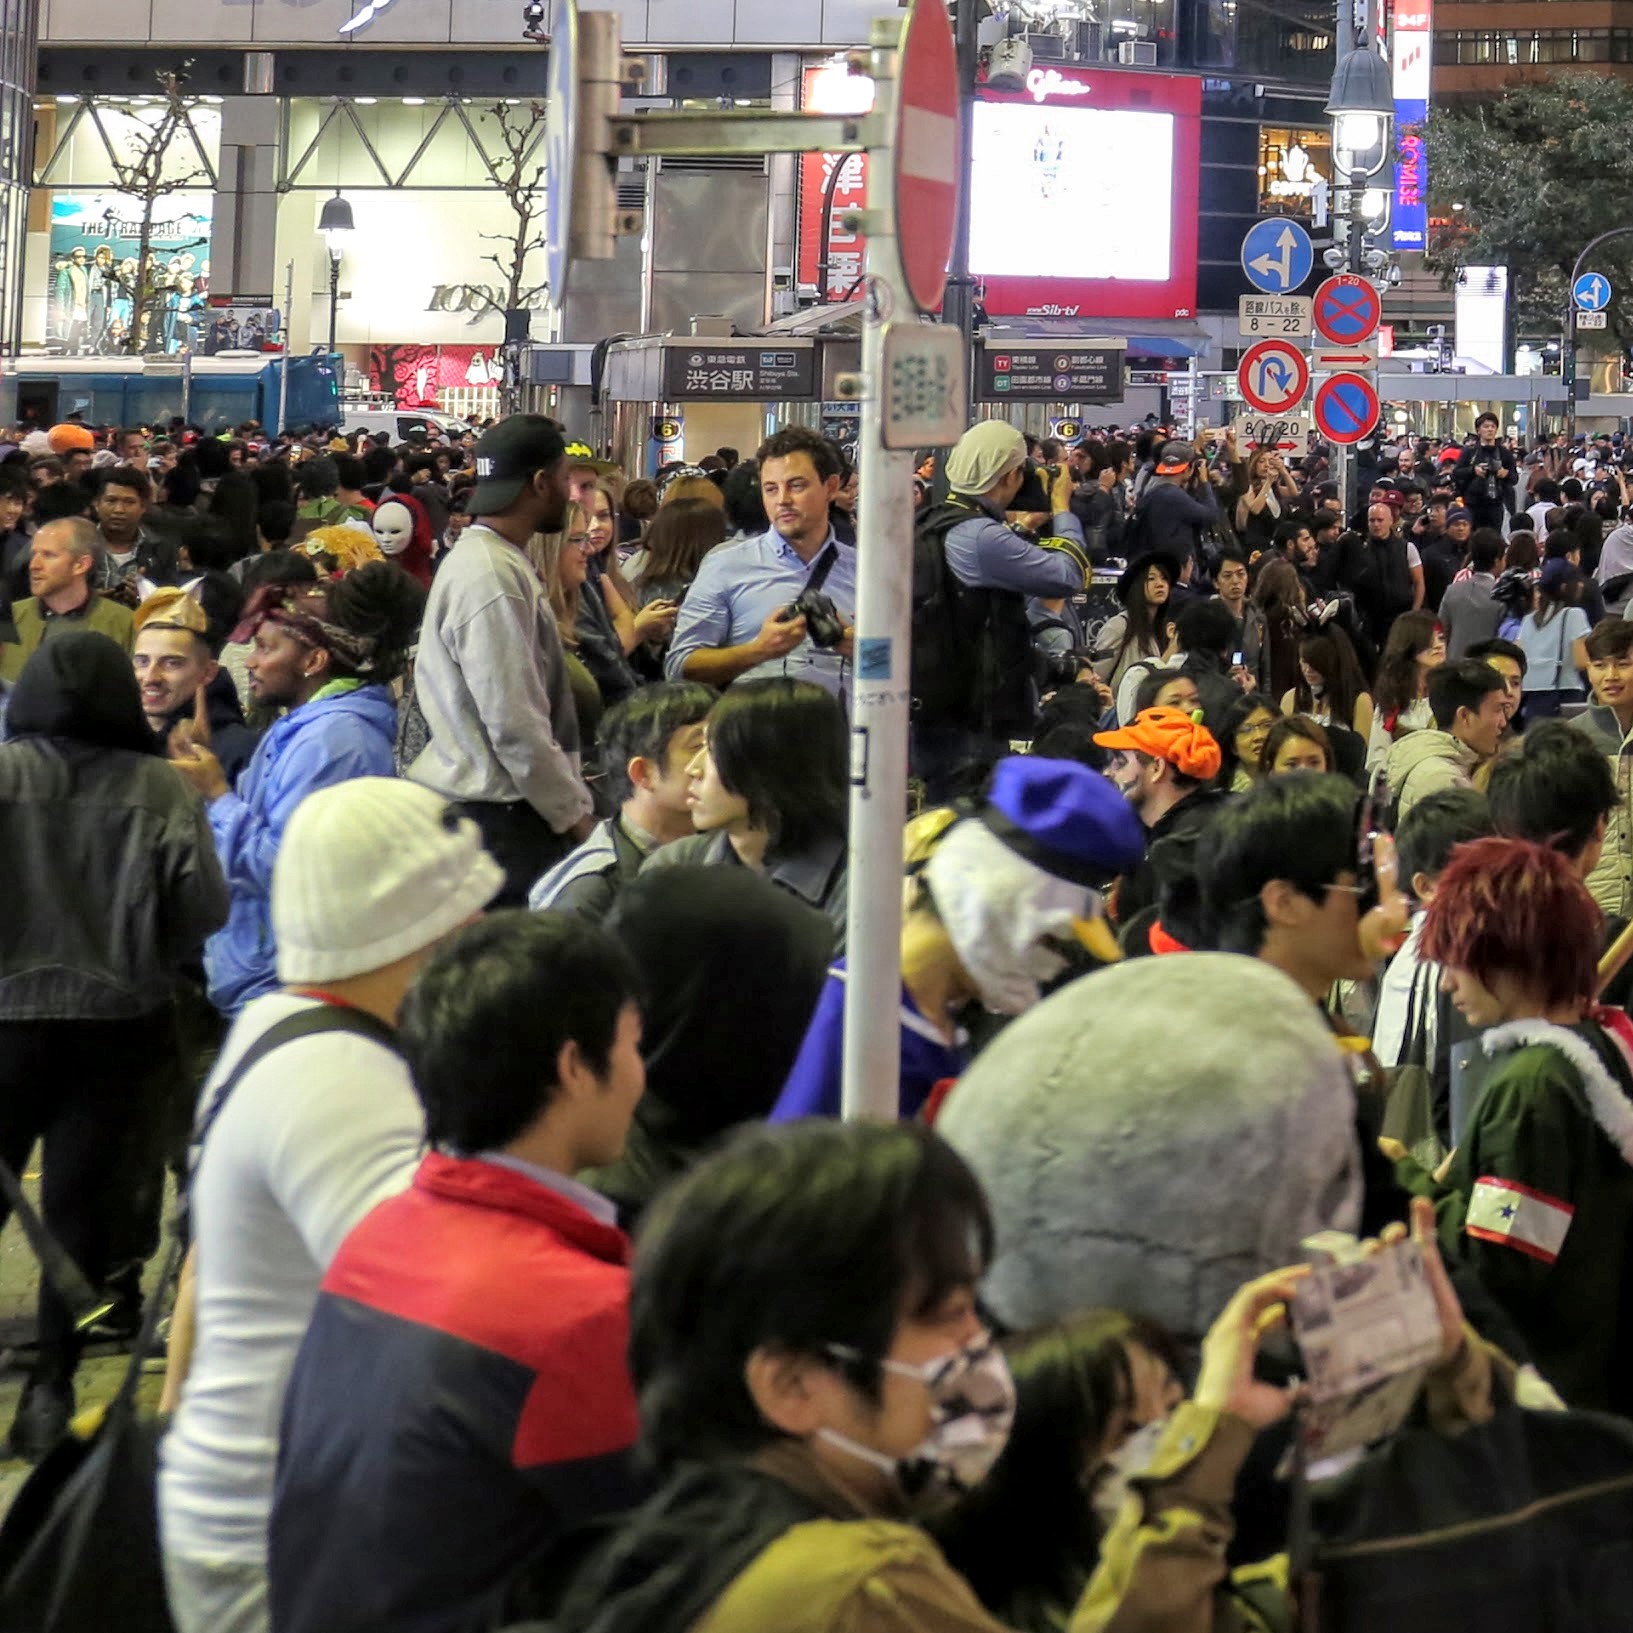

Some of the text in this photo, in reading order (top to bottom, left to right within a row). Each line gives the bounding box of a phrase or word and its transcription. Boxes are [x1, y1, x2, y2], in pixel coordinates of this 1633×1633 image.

[1245, 300, 1306, 315] 路線バスを除く
[1250, 317, 1259, 331] 8
[1282, 318, 1300, 332] 22
[685, 369, 754, 391] 渋谷駅
[661, 424, 673, 436] 6
[1063, 423, 1074, 436] 6
[1245, 422, 1254, 435] 8
